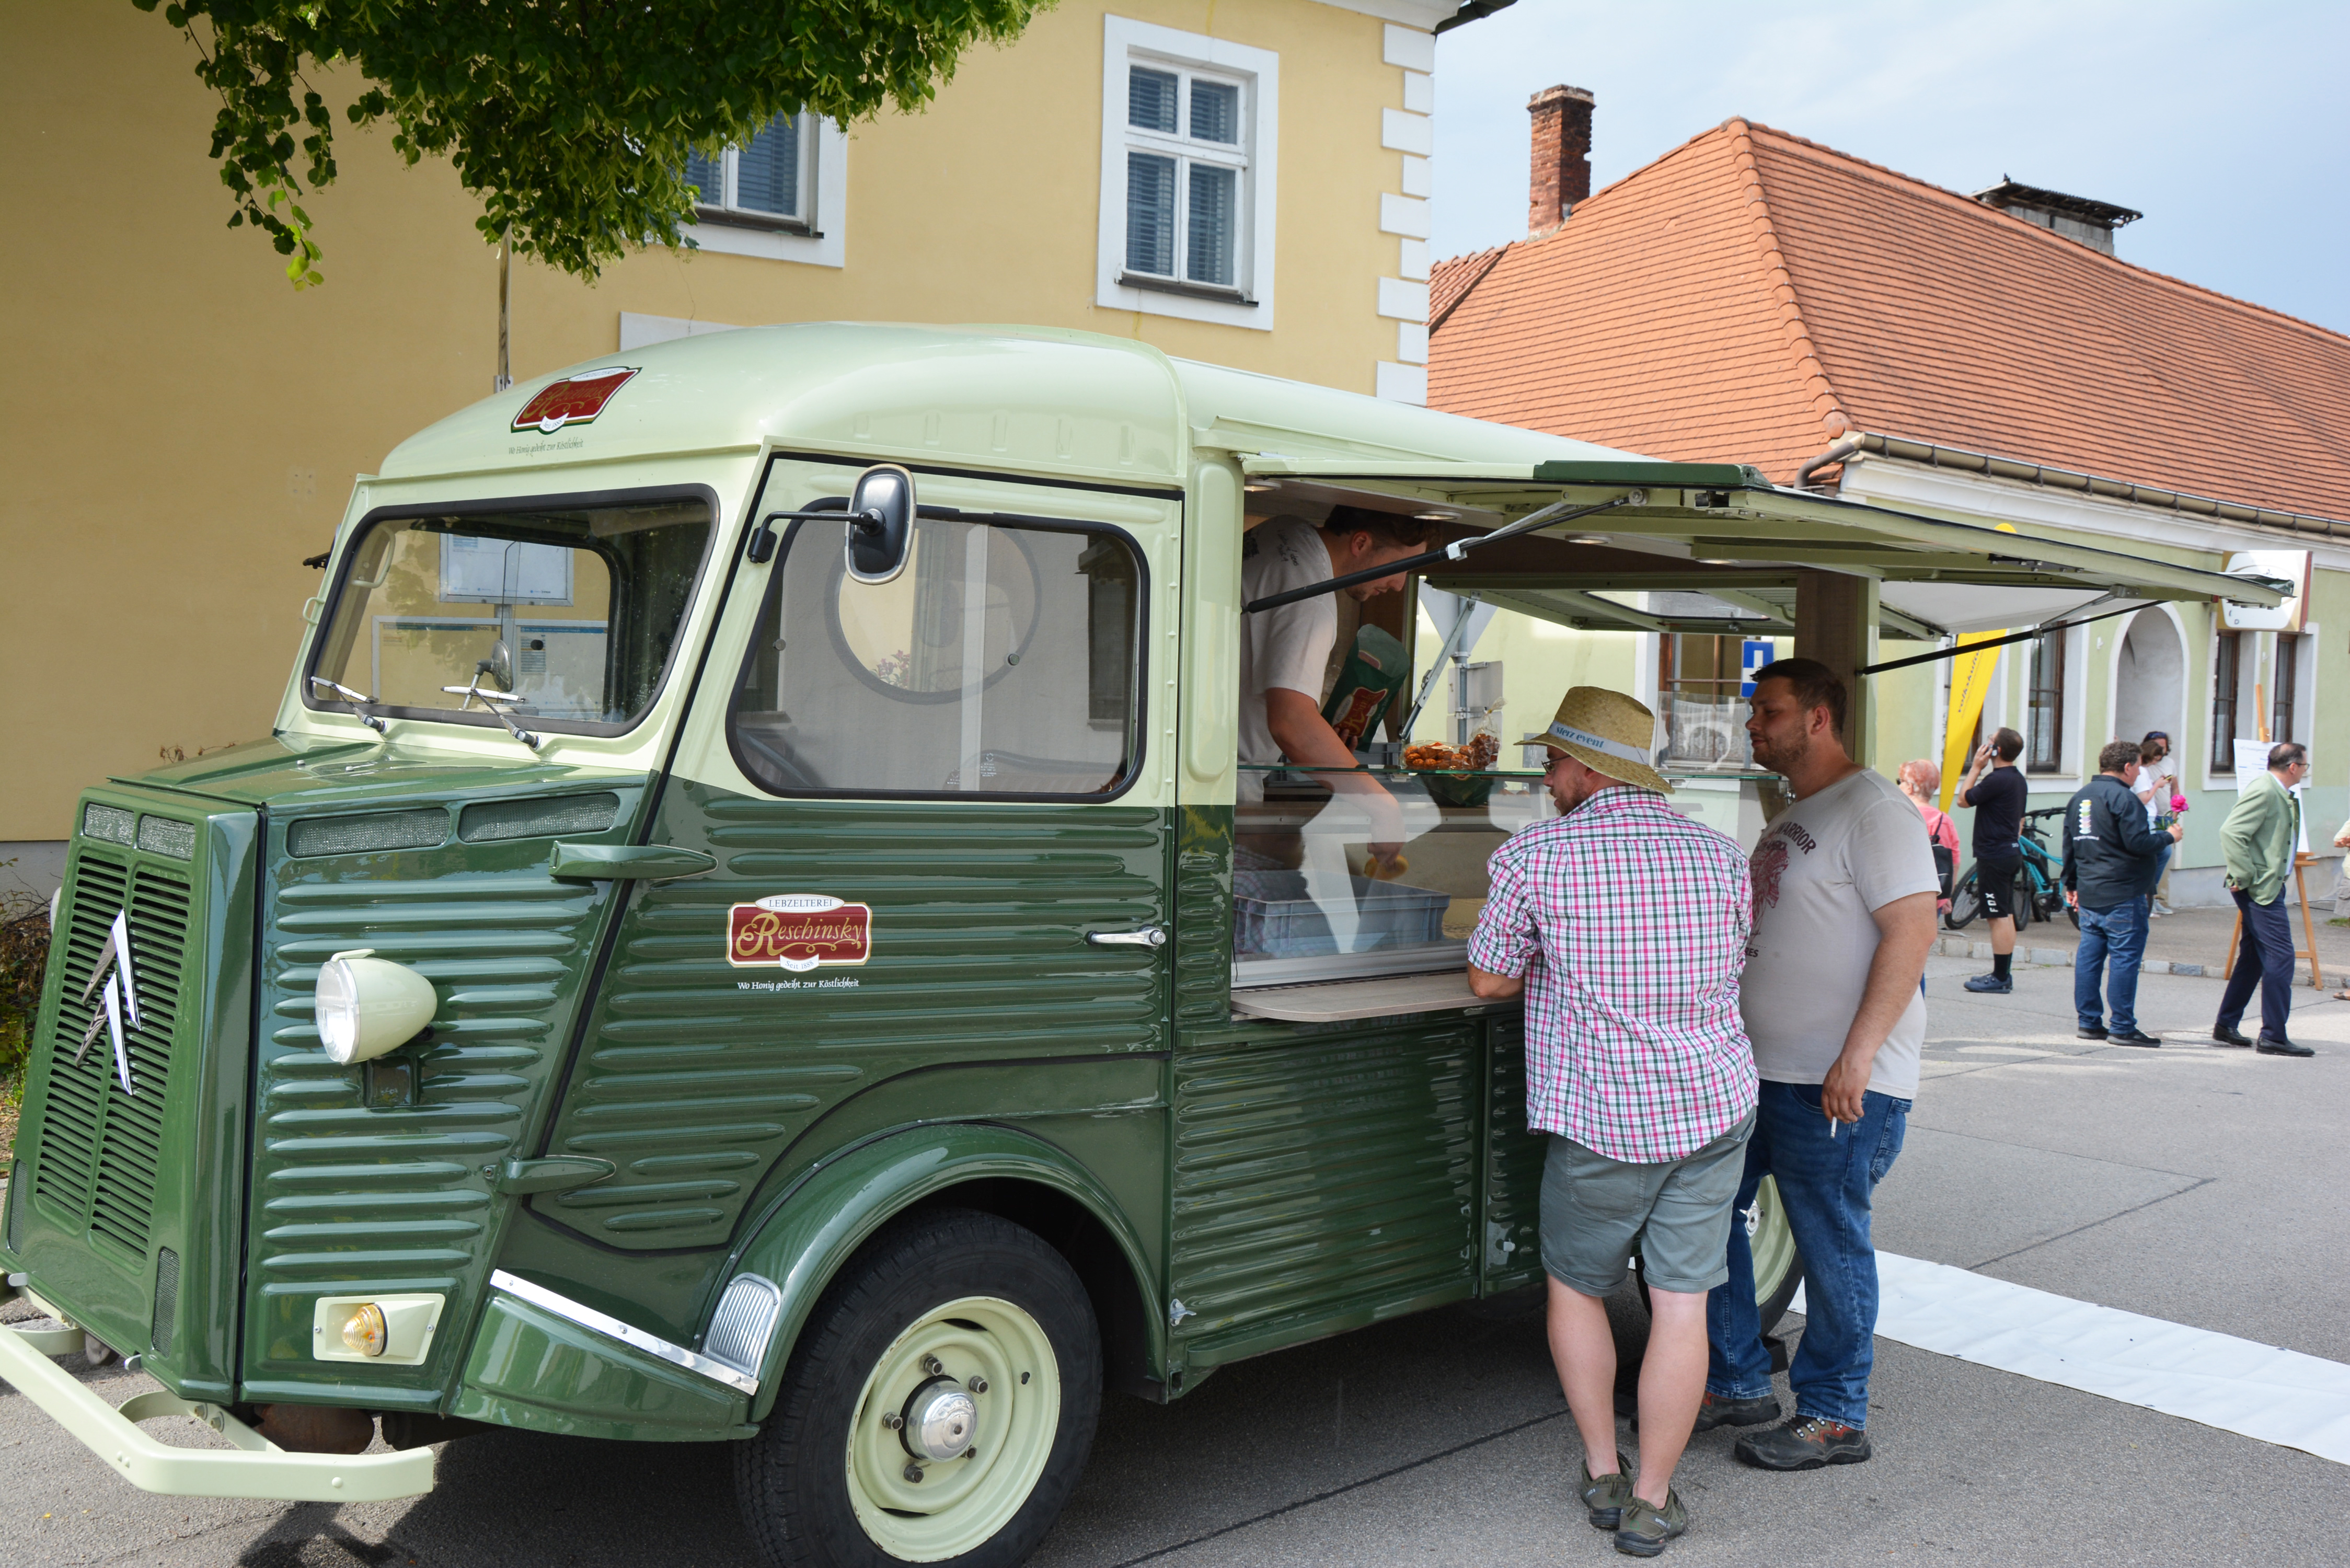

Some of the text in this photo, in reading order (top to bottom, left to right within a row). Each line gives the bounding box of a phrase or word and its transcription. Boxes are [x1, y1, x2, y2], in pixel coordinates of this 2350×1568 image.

[516, 444, 530, 456] Honig
[530, 440, 546, 454] gedeiht
[557, 437, 583, 450] Köstlichkeit
[1958, 650, 1980, 713] volkskultu
[1556, 727, 1604, 748] sterz event
[1776, 821, 1816, 855] WARRIOR
[769, 899, 832, 907] LEBZELTEREI
[1985, 893, 1999, 913] FOX
[735, 912, 862, 956] Reschinsky
[785, 960, 814, 969] Seit 1888
[751, 981, 774, 991] Honig
[776, 978, 801, 991] gedeiht
[819, 977, 859, 988] Köstlichkeit
